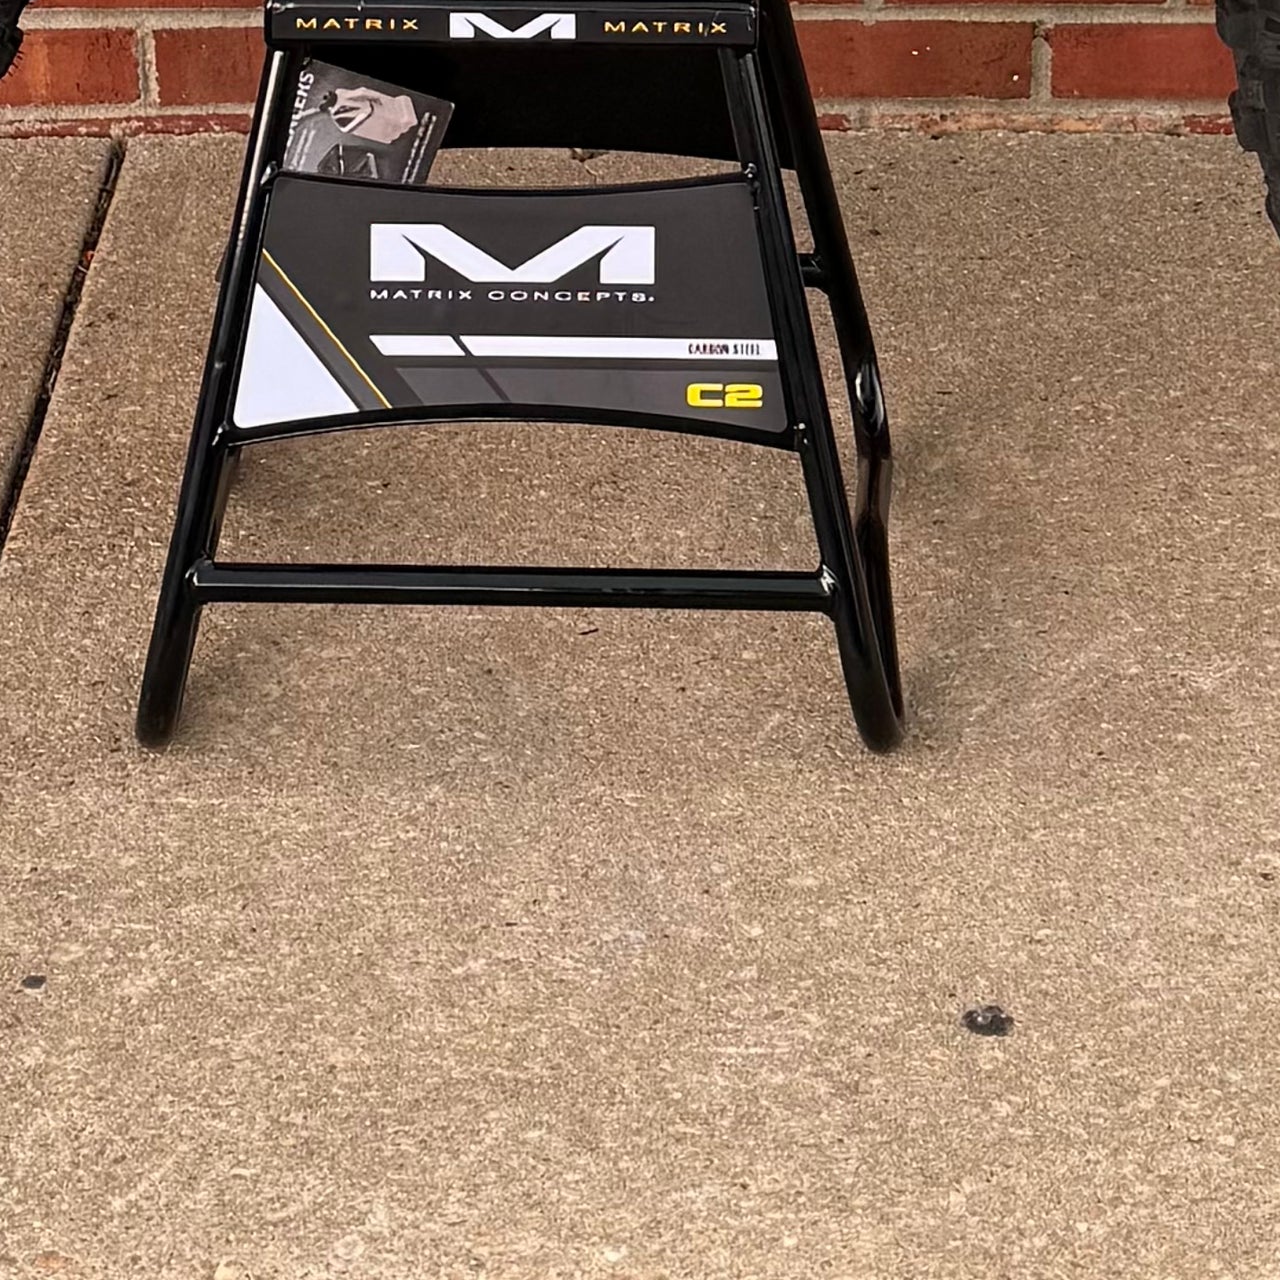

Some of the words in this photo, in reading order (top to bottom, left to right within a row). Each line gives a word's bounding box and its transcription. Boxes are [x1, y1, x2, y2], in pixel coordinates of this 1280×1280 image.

[295, 16, 419, 31] MATRIX
[603, 19, 728, 35] MATRIX
[369, 289, 473, 302] MATRIX
[685, 382, 764, 409] C2
